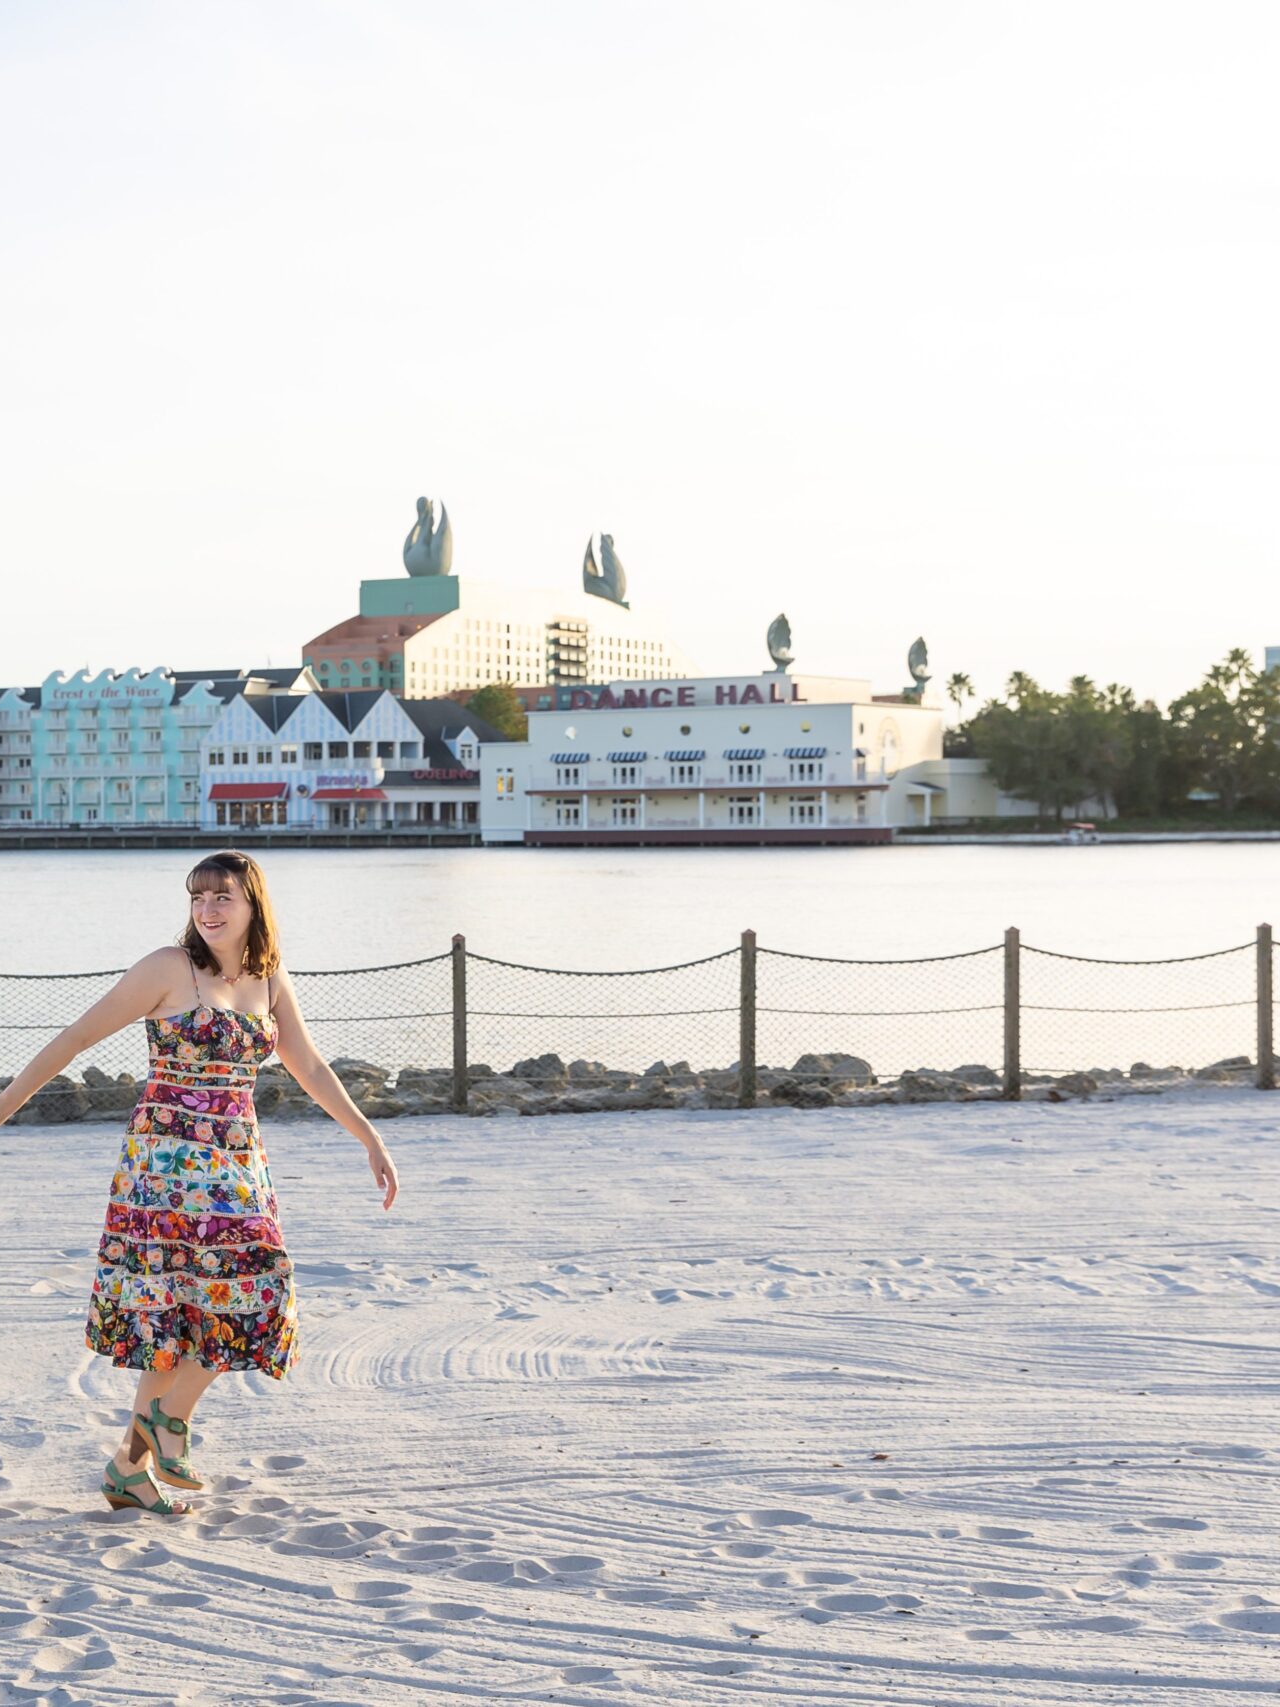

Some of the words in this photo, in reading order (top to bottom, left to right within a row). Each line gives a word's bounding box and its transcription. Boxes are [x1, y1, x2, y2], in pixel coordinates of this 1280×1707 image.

[52, 688, 83, 699] Crest
[101, 686, 119, 698] the
[125, 685, 160, 697] Wave
[570, 686, 696, 710] DANCE
[715, 682, 808, 706] HALL
